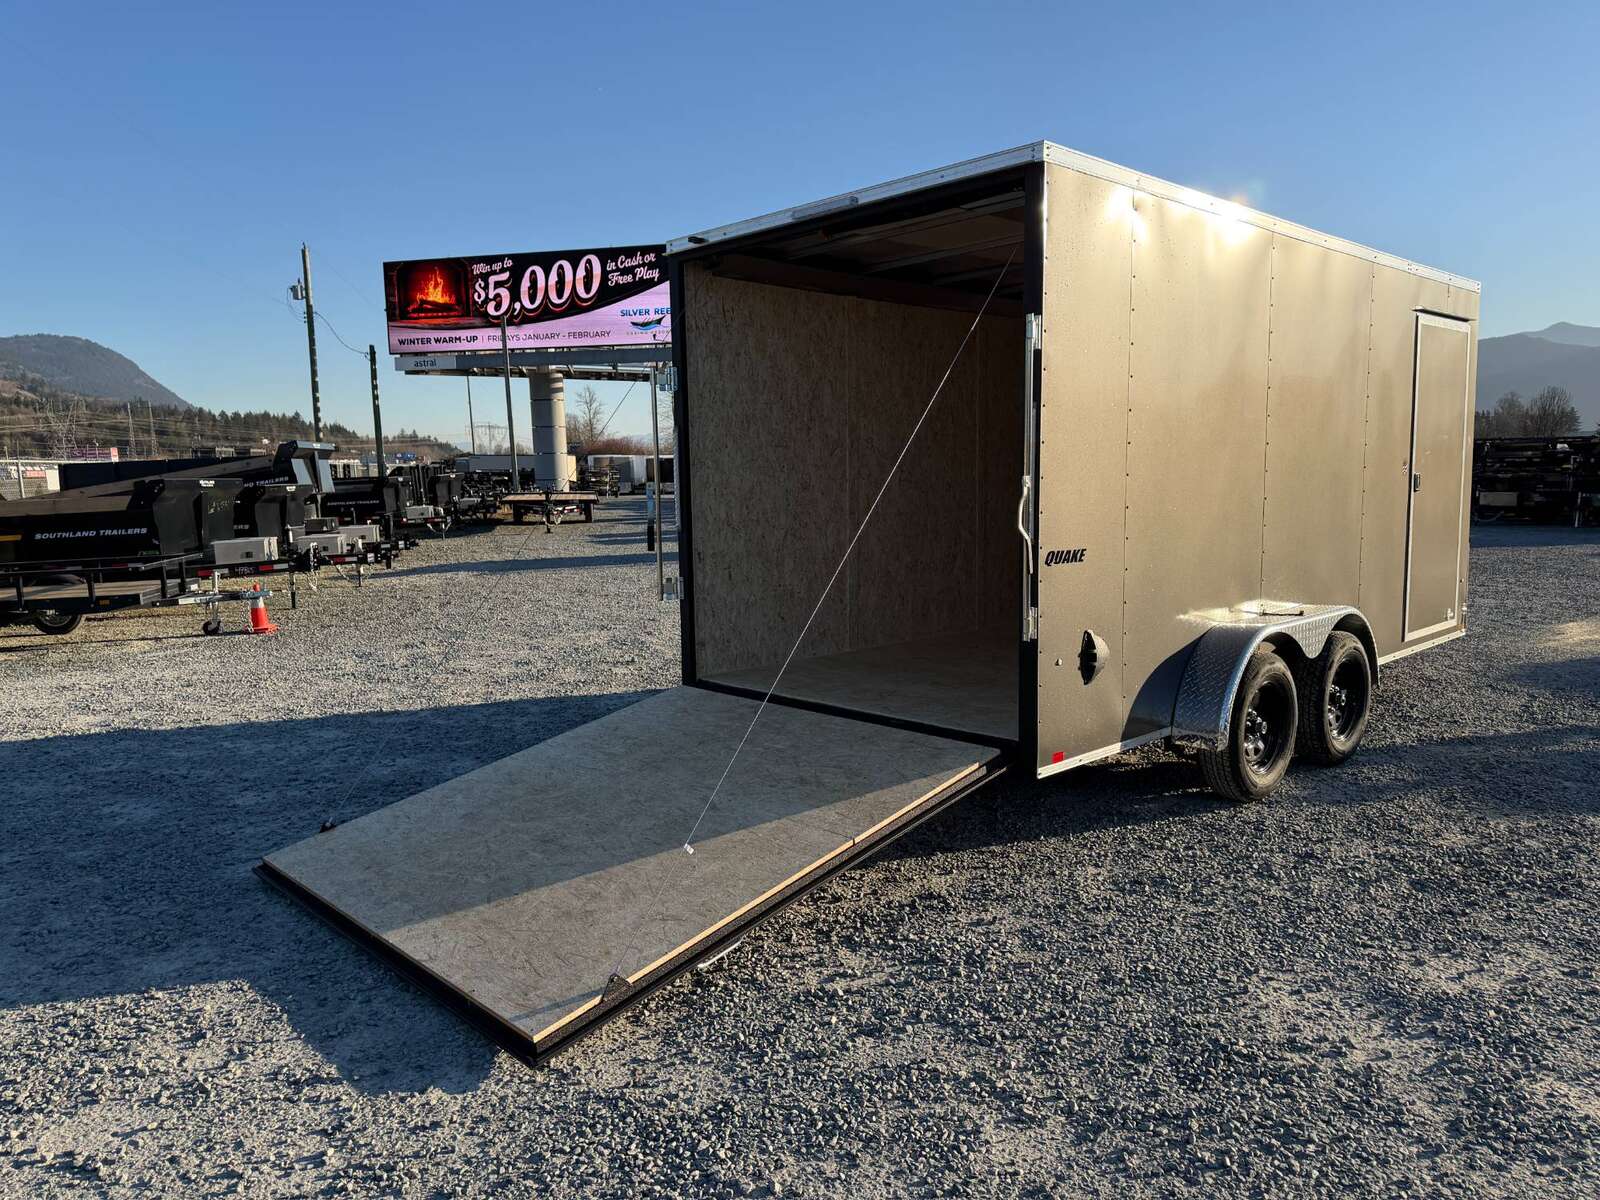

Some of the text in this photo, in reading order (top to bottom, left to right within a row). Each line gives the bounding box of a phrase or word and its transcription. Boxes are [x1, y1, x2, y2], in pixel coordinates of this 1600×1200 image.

[472, 257, 513, 275] Win up to
[606, 251, 656, 271] in Cash or
[473, 254, 602, 316] $5,000
[608, 265, 660, 287] Free Play
[620, 308, 651, 317] SILVER
[397, 336, 432, 346] WINTER
[433, 335, 479, 345] WARM-UP
[521, 332, 561, 341] JANUARY
[567, 330, 612, 339] FEBRUARY
[414, 358, 437, 368] astral
[34, 527, 148, 540] SOUTHLAND TRAILERS
[1044, 548, 1087, 567] QUAKE
